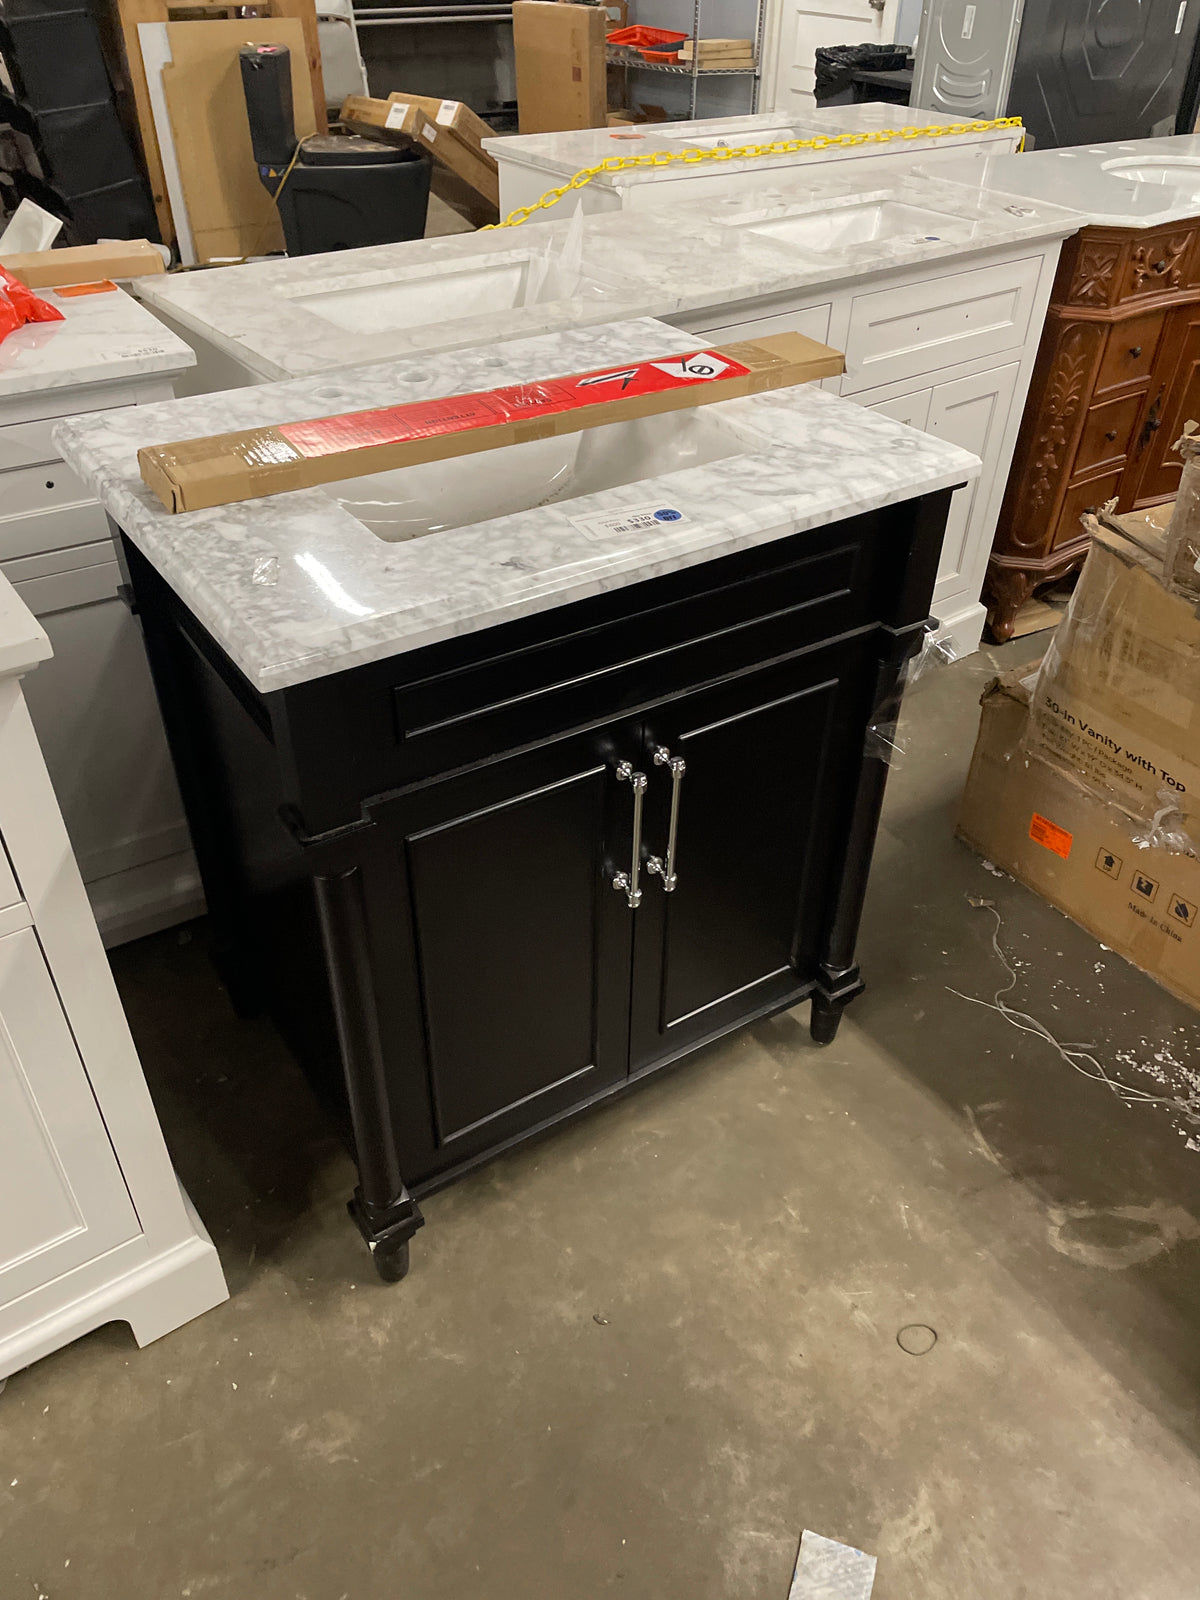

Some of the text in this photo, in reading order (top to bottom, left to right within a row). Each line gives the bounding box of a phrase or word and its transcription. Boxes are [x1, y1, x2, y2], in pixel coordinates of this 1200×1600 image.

[1045, 696, 1075, 725] 30-in
[1079, 719, 1121, 754] Vanity
[1125, 750, 1156, 775] with
[1159, 769, 1186, 792] Top
[1098, 749, 1132, 774] Package
[1128, 901, 1147, 918] Made
[1160, 923, 1182, 943] China
